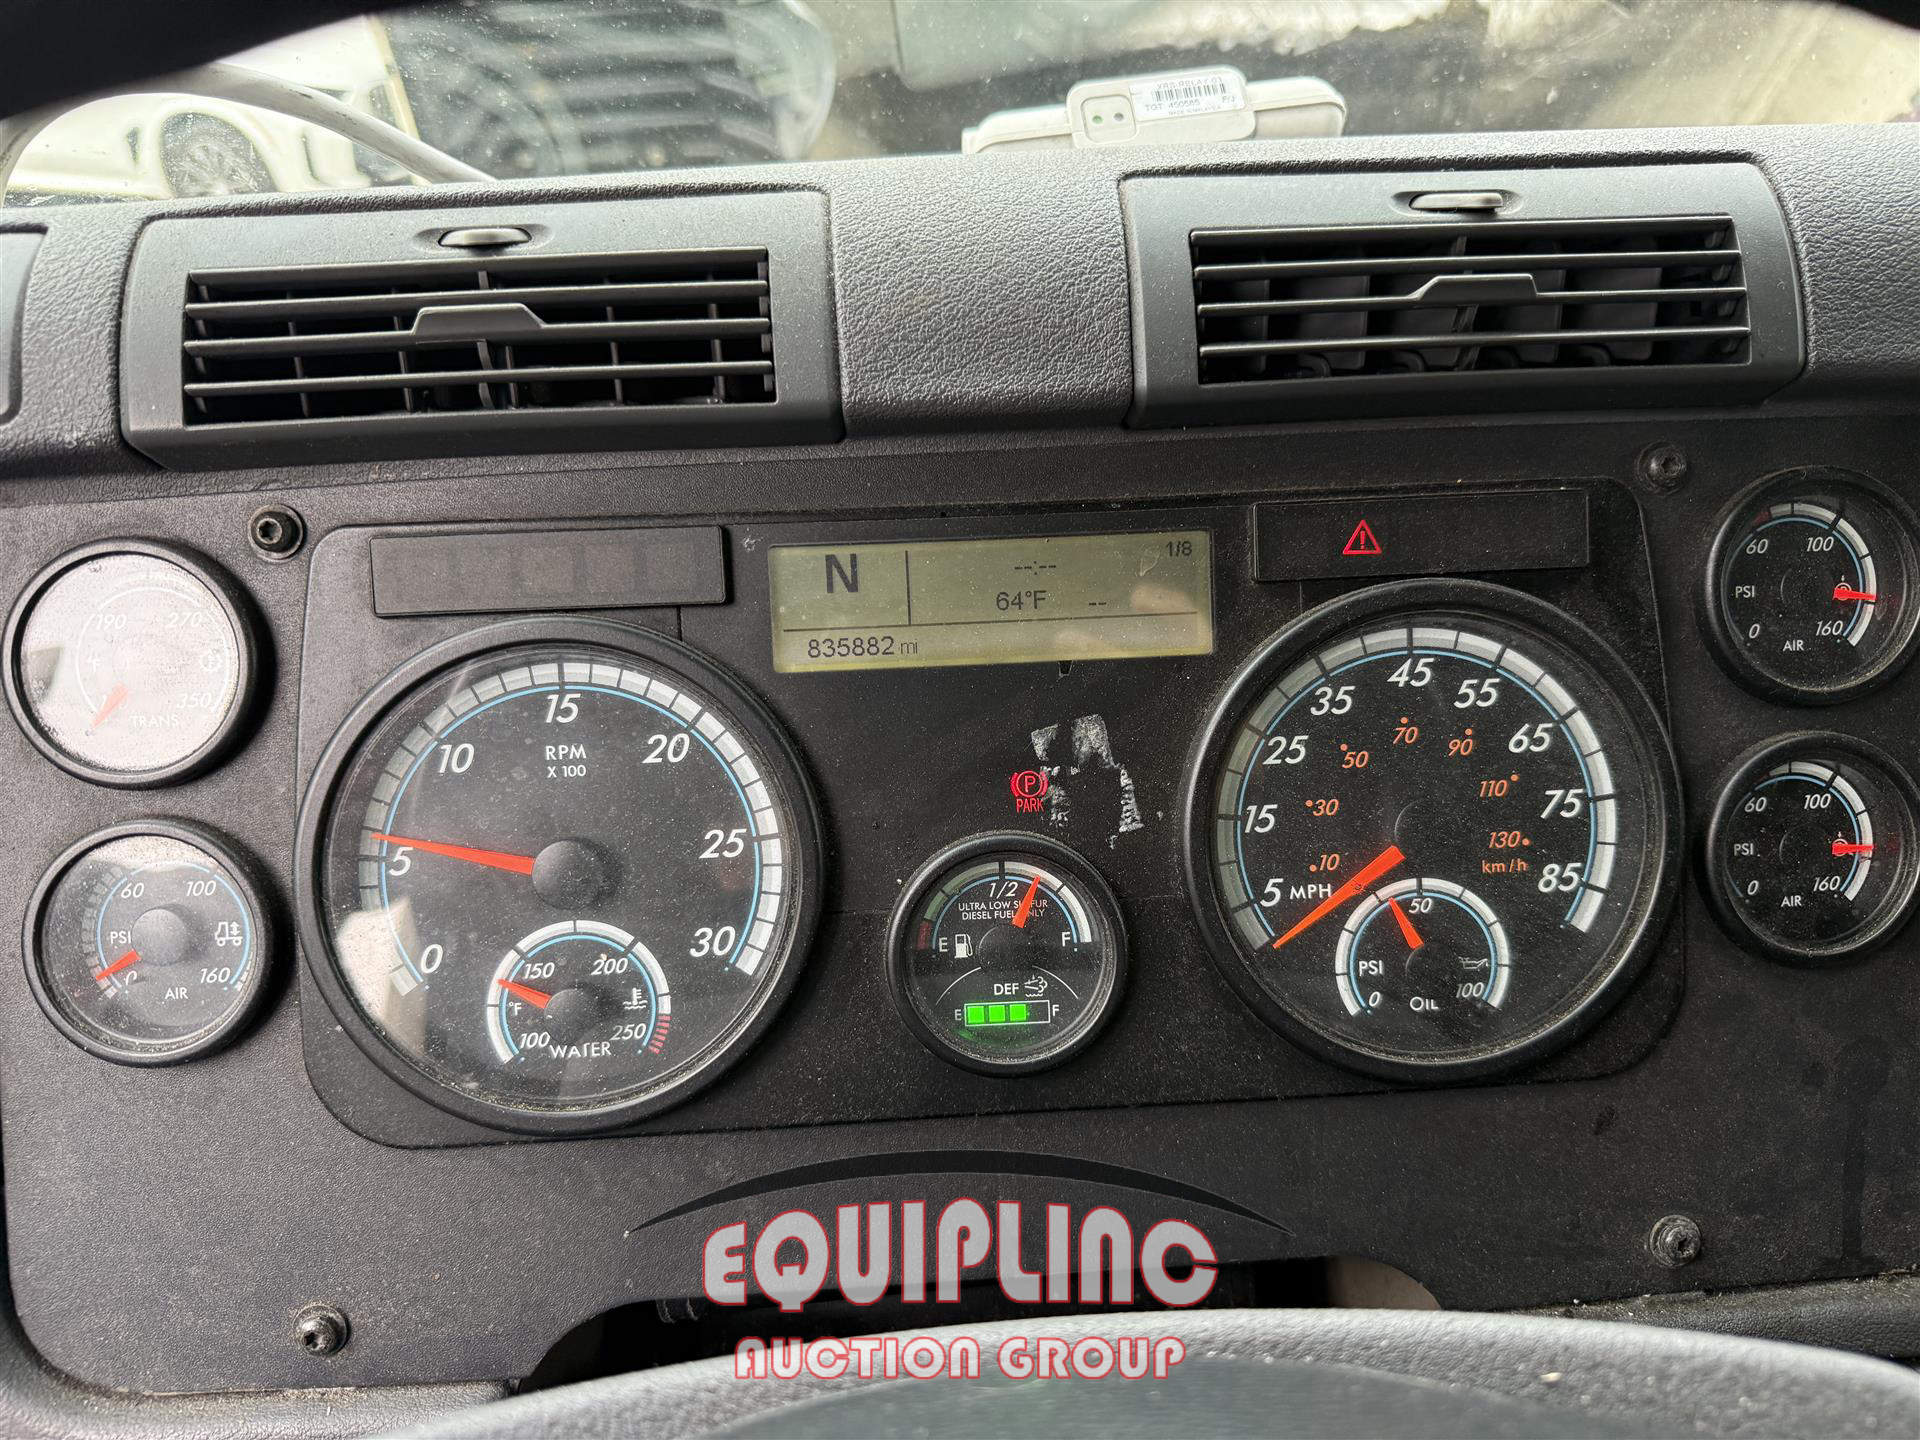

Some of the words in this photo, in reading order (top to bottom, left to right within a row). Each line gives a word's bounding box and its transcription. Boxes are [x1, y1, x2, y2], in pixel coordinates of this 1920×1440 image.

[1166, 541, 1193, 557] 1/8
[1746, 538, 1769, 554] 60
[1806, 536, 1834, 552] 100
[825, 552, 859, 594] N
[995, 589, 1047, 611] 64°F
[1735, 585, 1755, 598] PSI
[96, 613, 127, 630] 190
[165, 612, 200, 628] 270
[1815, 620, 1843, 636] 160
[1749, 623, 1760, 639] 0
[808, 636, 895, 658] 835882
[900, 638, 918, 655] mi
[1783, 639, 1805, 651] AIR
[1388, 658, 1434, 687] 45
[176, 693, 212, 709] 350
[1310, 686, 1355, 715] 35
[1453, 679, 1500, 708] 55
[544, 693, 581, 723] 15
[131, 714, 179, 728] TRANS
[1393, 727, 1418, 745] 70
[1508, 723, 1552, 754] 65
[545, 745, 587, 760] RPM
[642, 733, 690, 764] 20
[1263, 735, 1308, 766] 25
[1448, 738, 1474, 756] 90
[438, 743, 474, 774] 10
[1342, 751, 1369, 768] 50
[547, 765, 557, 778] X
[561, 764, 587, 777] 100
[1479, 780, 1508, 797] 110
[1016, 798, 1044, 813] PARK
[1312, 799, 1339, 816] 30
[1540, 789, 1584, 818] 75
[1744, 796, 1767, 812] 60
[1803, 794, 1831, 809] 100
[1244, 804, 1278, 833] 15
[700, 829, 745, 859] 25
[1488, 831, 1521, 848] 130
[1733, 843, 1754, 856] PSI
[388, 848, 413, 876] 5
[1319, 854, 1340, 871] 10
[1537, 863, 1581, 893] 85
[1813, 876, 1841, 892] 160
[120, 882, 145, 899] 60
[186, 880, 216, 896] 100
[988, 881, 1019, 898] 1/2
[1261, 878, 1283, 907] 5
[1289, 883, 1332, 900] MPH
[1747, 880, 1759, 896] 0
[958, 901, 988, 912] ULTRA
[989, 900, 1013, 910] LOW
[1408, 898, 1432, 914] 50
[1781, 895, 1802, 907] AIR
[962, 910, 992, 921] DIESEL
[994, 908, 1016, 919] FUEL
[110, 930, 131, 944] PSI
[689, 926, 736, 957] 30
[938, 937, 948, 952] E
[1062, 931, 1071, 947] F
[420, 944, 443, 974] 0
[591, 957, 628, 975] 200
[1358, 960, 1384, 975] PSI
[199, 967, 231, 984] 160
[523, 962, 555, 979] 150
[164, 986, 188, 1000] AIR
[993, 983, 1019, 996] DEF
[1455, 982, 1484, 998] 100
[1368, 991, 1381, 1007] 0
[954, 1009, 962, 1021] E
[1052, 1005, 1060, 1016] F
[519, 1031, 550, 1049] 100
[609, 1023, 647, 1041] 250
[550, 1041, 611, 1058] WATER
